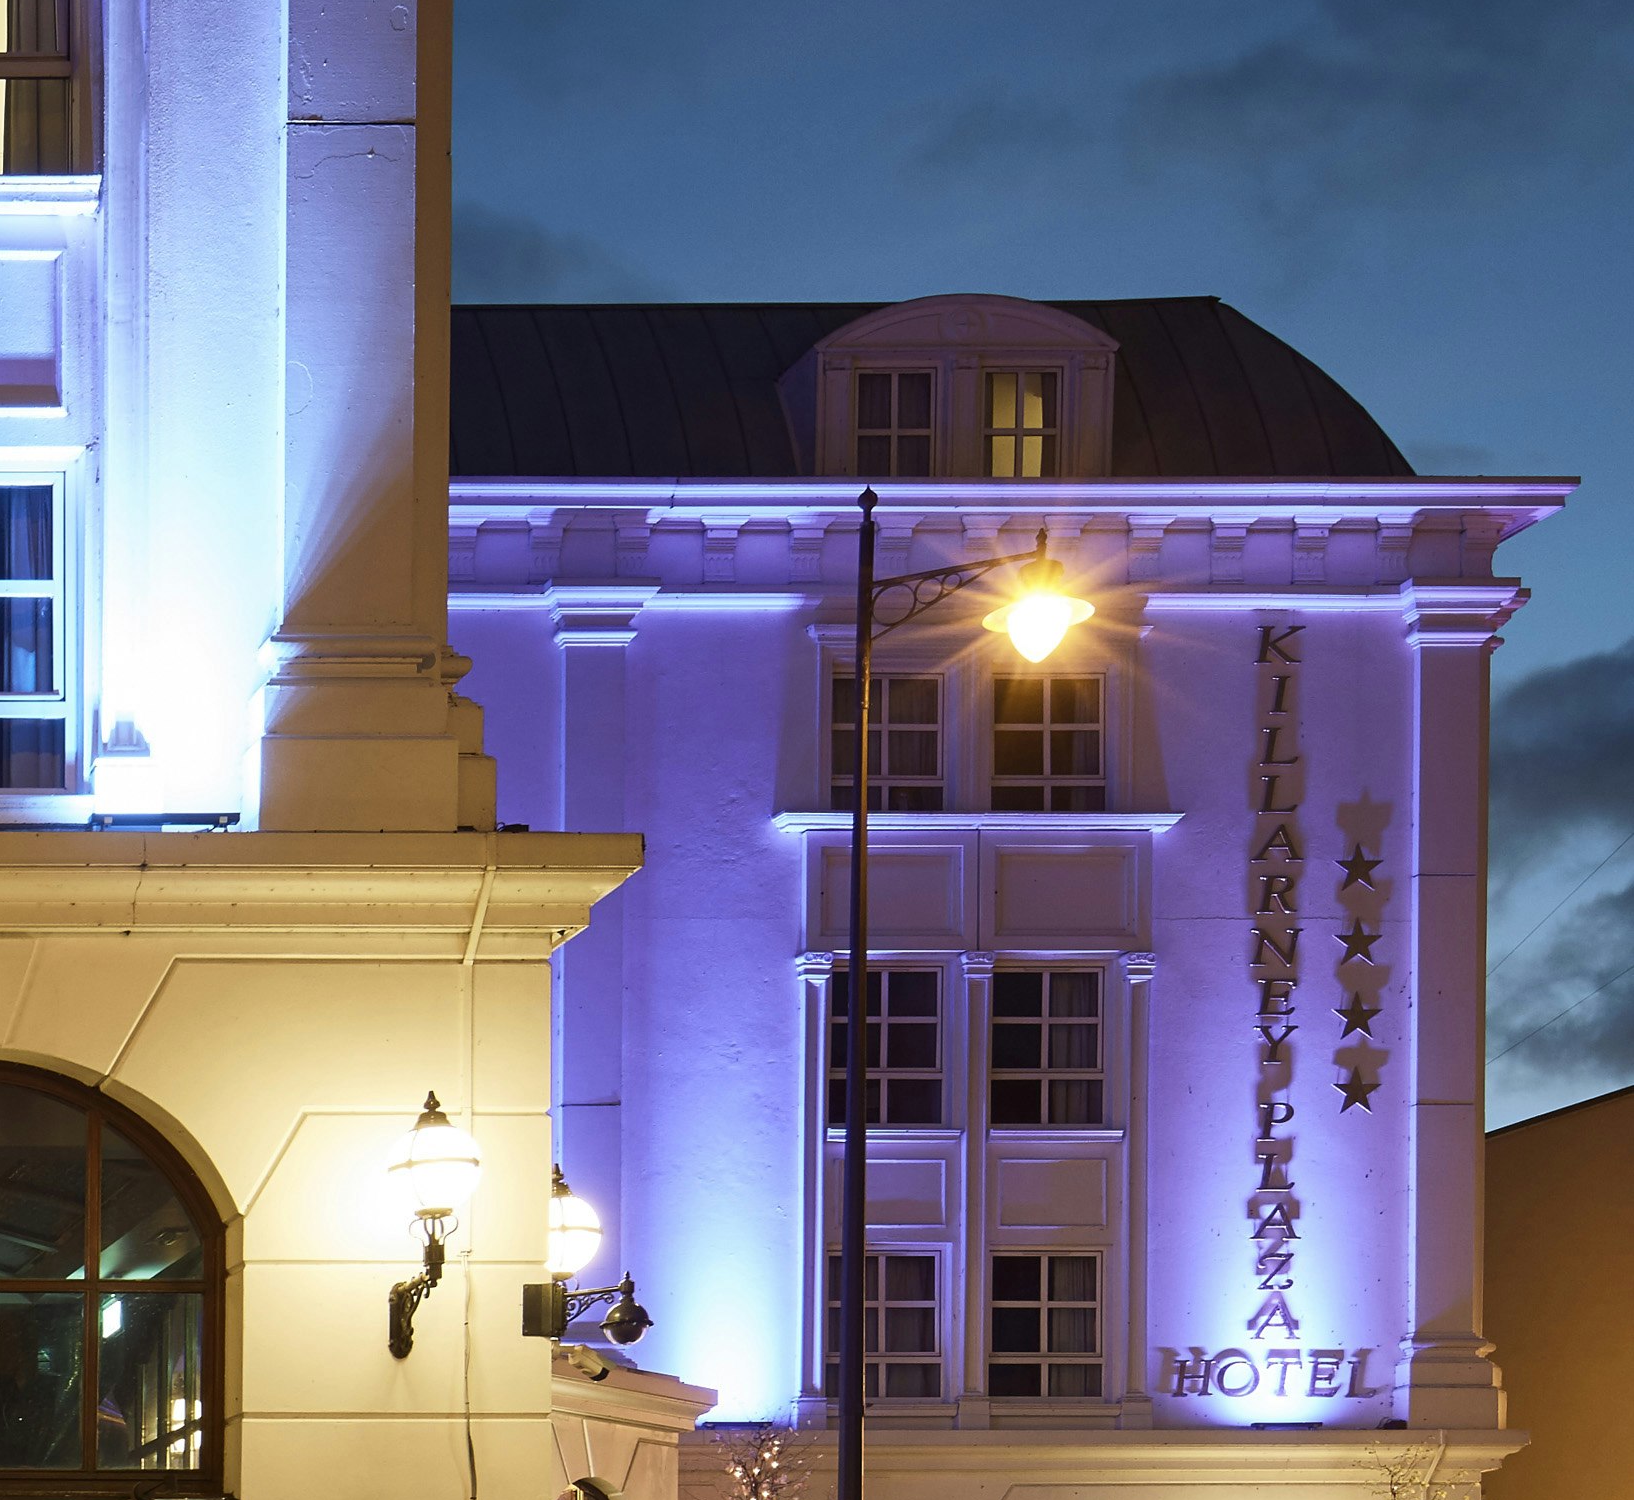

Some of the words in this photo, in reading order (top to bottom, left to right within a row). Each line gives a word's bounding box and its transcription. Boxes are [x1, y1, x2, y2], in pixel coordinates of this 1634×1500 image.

[1250, 625, 1307, 1064] KILLARNEY
[1248, 1102, 1302, 1340] PLAZA
[1171, 1359, 1377, 1398] HOTEL
